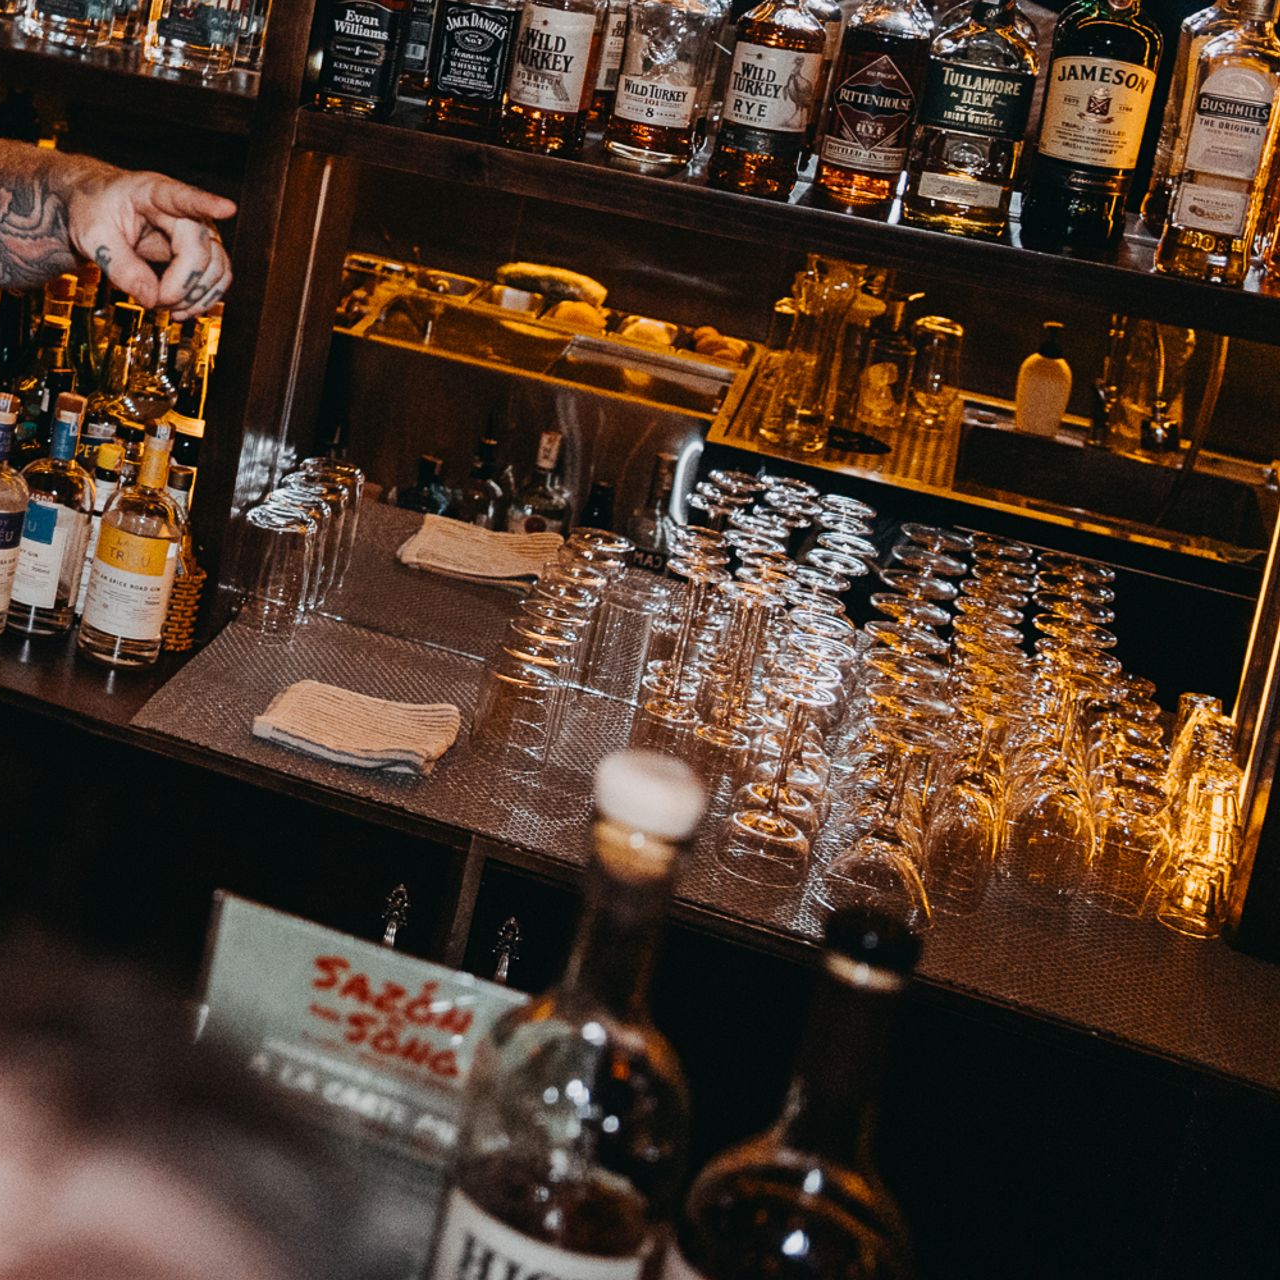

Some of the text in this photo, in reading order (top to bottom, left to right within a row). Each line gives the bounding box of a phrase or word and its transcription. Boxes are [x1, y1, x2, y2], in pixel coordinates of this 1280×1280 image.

[344, 8, 381, 28] Evan
[445, 11, 510, 41] JACK DANIEL'S
[333, 18, 390, 42] Williams
[526, 26, 567, 54] WILD
[332, 60, 378, 76] KENTUCKY
[449, 60, 491, 74] WHISKEY
[516, 39, 575, 74] TURKEY
[332, 74, 373, 89] BOURBON
[741, 60, 778, 84] WILD
[942, 65, 1024, 97] TULLAMORE
[1057, 64, 1149, 95] JAMESON
[624, 78, 689, 104] WILD TURKEY
[732, 71, 784, 100] TURKEY
[733, 98, 768, 119] RYE
[839, 86, 914, 112] RITTENHOUSE
[1200, 97, 1270, 120] BUSHMILLS
[645, 106, 655, 118] 8
[967, 114, 1004, 128] WHISKEY
[855, 122, 887, 138] RYE
[1199, 117, 1262, 137] THE ORIGINAL
[109, 576, 128, 588] SPICE
[129, 583, 149, 593] ROAD
